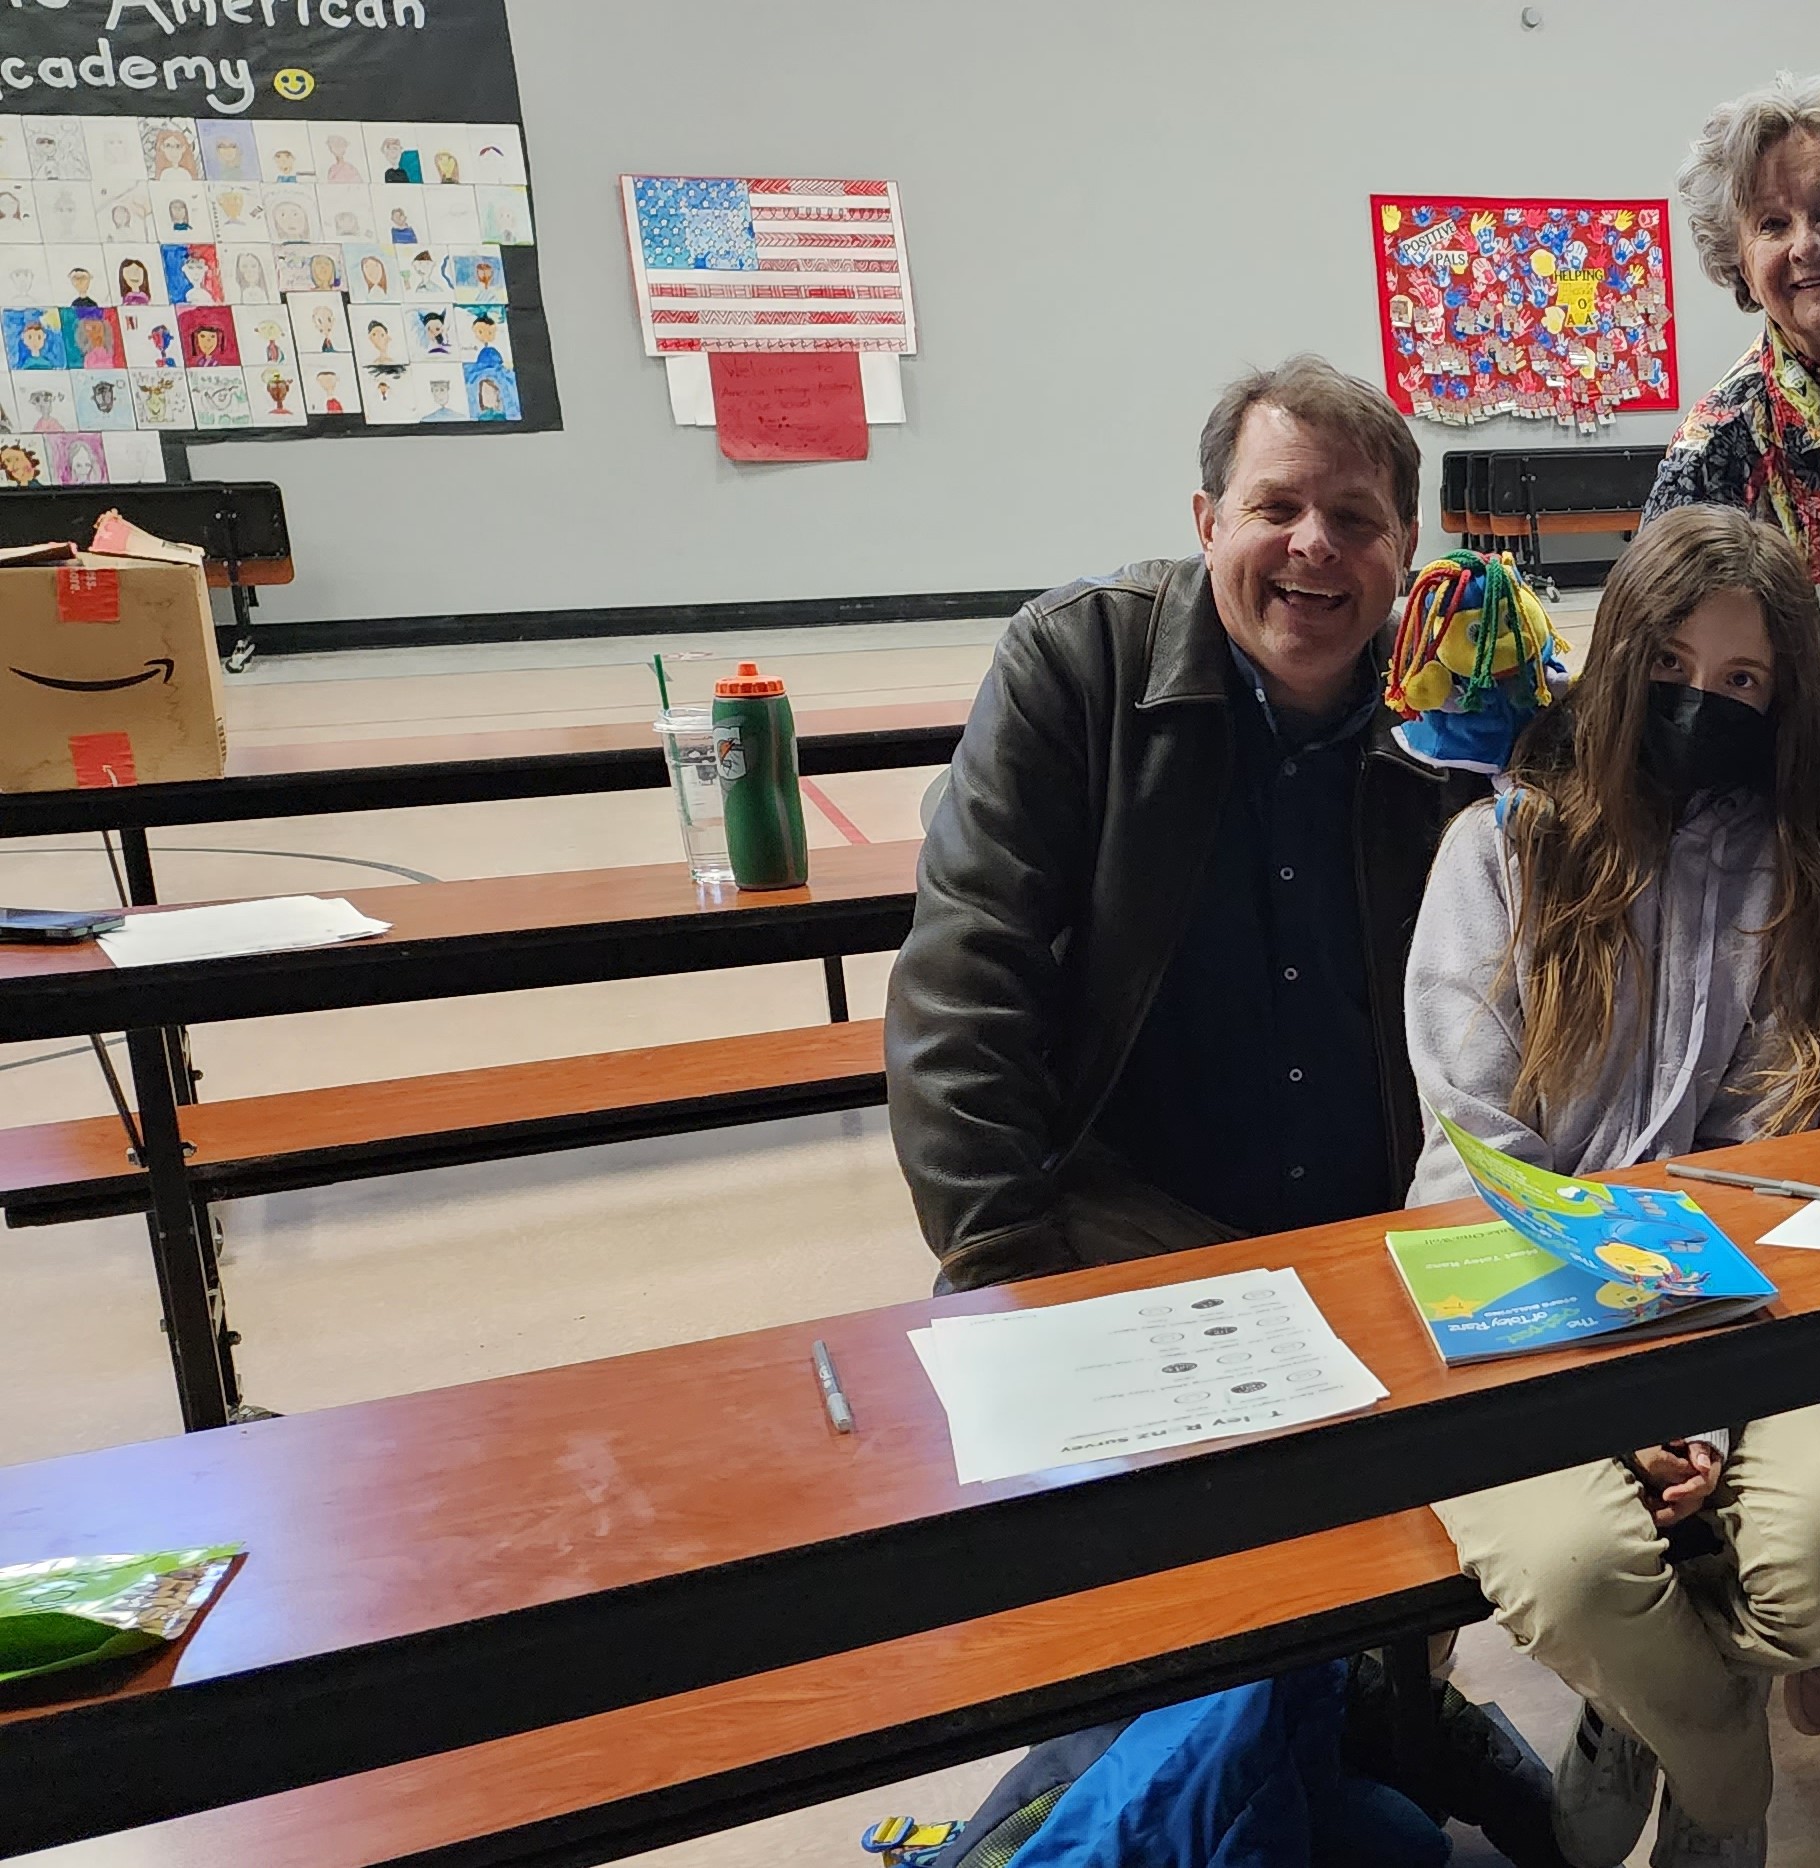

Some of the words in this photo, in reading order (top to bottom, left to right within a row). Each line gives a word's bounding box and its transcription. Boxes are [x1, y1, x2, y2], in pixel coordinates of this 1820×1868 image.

[105, 0, 426, 35] American
[0, 37, 255, 115] cademy
[1402, 222, 1457, 256] POSITIVE
[1435, 253, 1466, 265] PALS
[1554, 269, 1603, 282] HELPING
[1447, 1319, 1490, 1332] Ranz
[1491, 1314, 1534, 1328] Toley
[1566, 1316, 1599, 1329] The
[1211, 1410, 1284, 1427] Tley
[1136, 1423, 1203, 1440] Rnz
